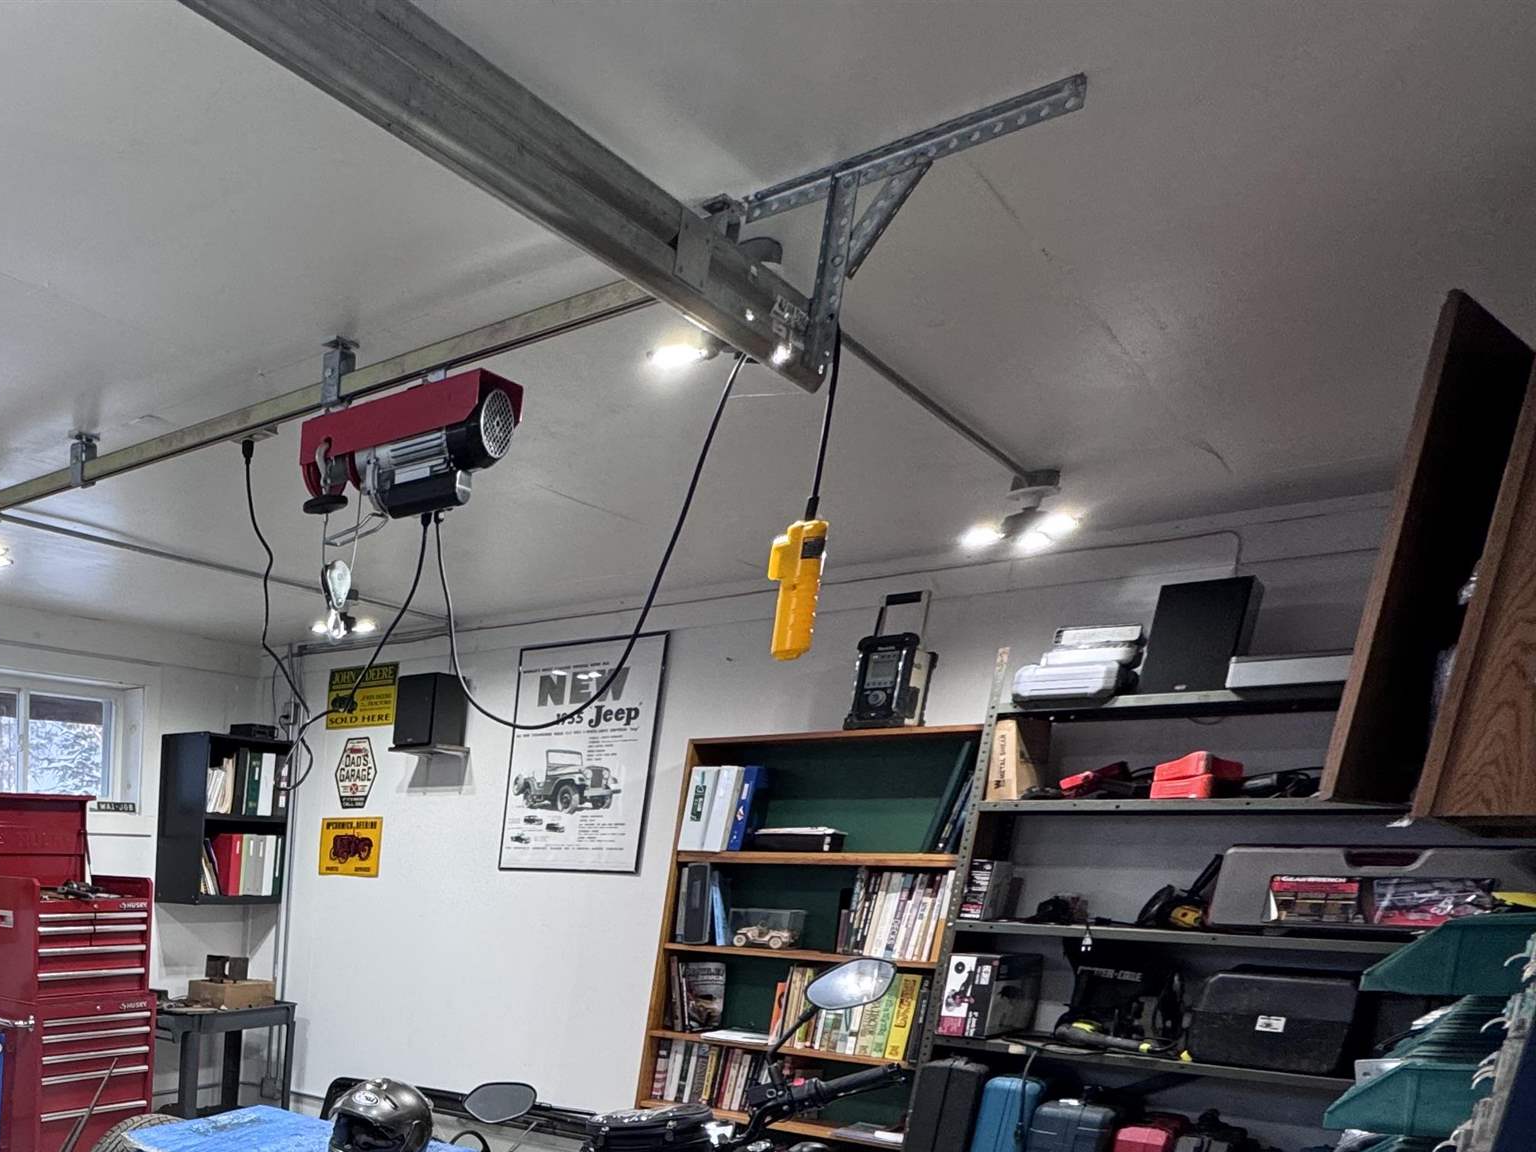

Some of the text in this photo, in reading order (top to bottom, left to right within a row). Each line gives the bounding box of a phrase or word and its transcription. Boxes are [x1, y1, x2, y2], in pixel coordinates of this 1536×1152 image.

[332, 664, 396, 685] JOHN DEERE
[537, 666, 631, 707] NEW
[329, 713, 391, 725] SOLD HERE
[345, 753, 369, 767] DAD'S
[339, 766, 372, 782] GARAGE
